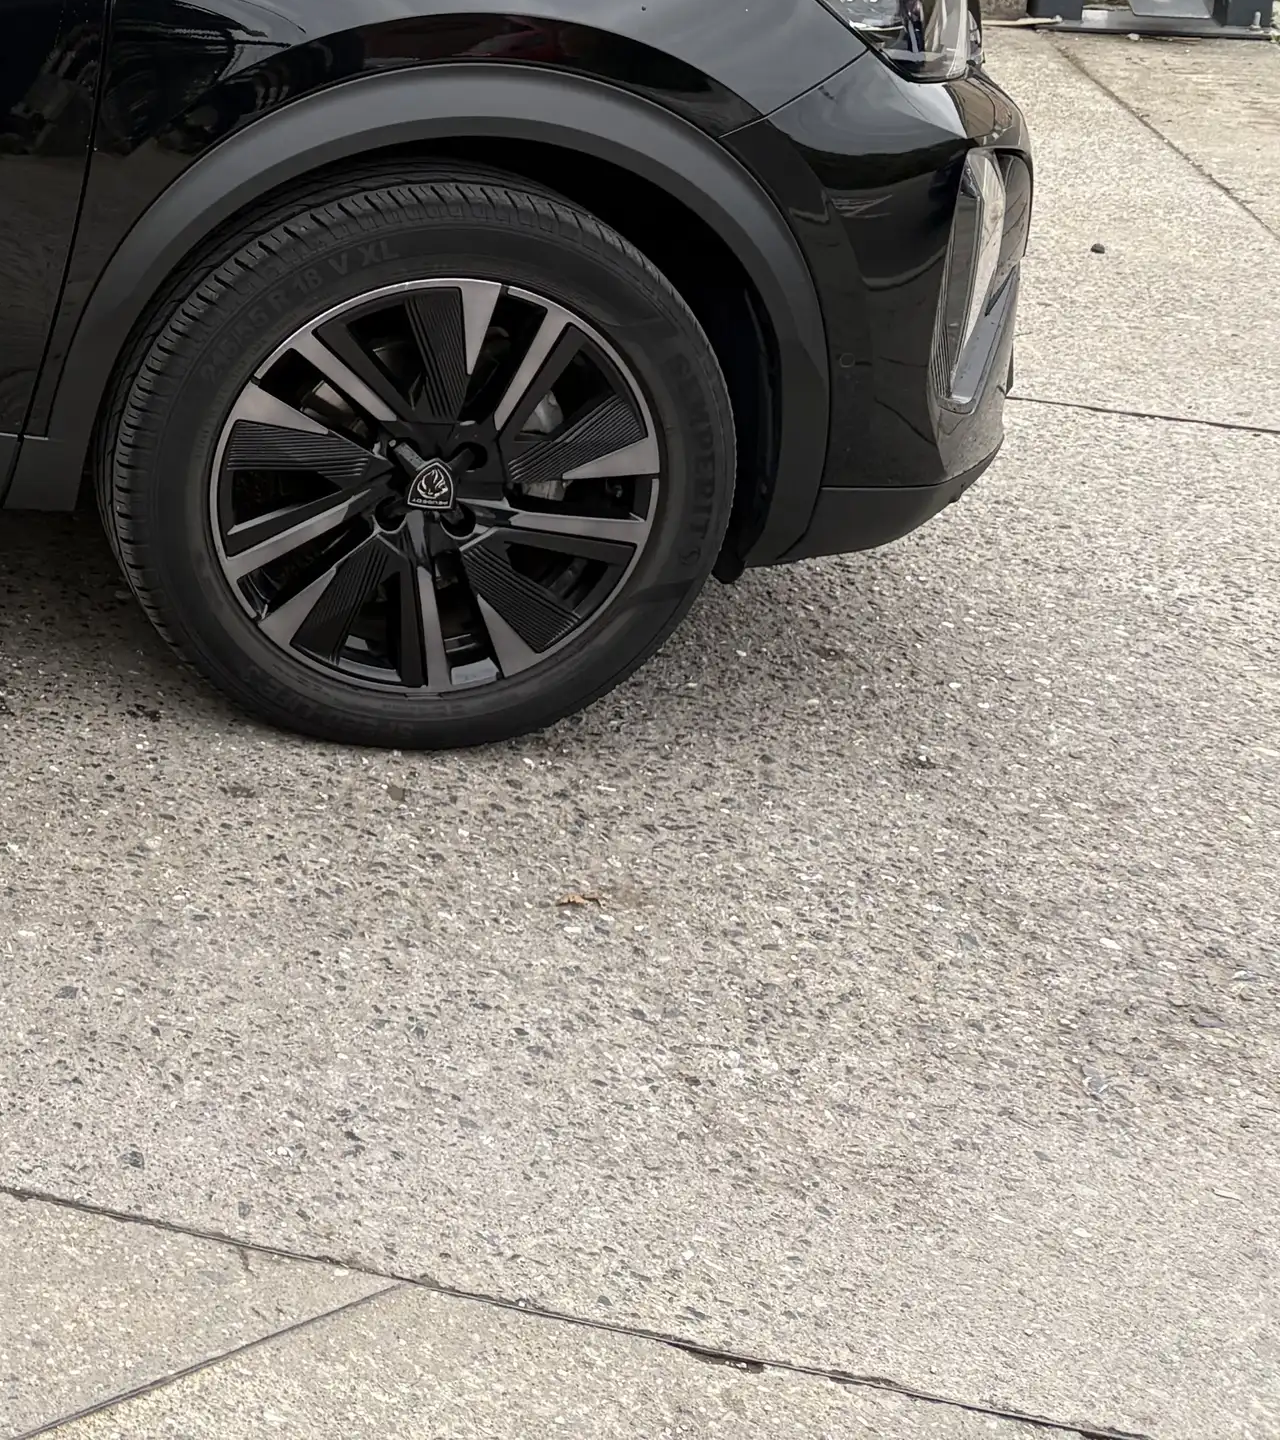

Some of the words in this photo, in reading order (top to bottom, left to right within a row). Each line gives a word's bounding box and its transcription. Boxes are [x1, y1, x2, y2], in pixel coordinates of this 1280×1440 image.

[266, 289, 291, 313] R
[293, 268, 323, 294] 18
[328, 252, 351, 277] V
[358, 240, 401, 267] XL
